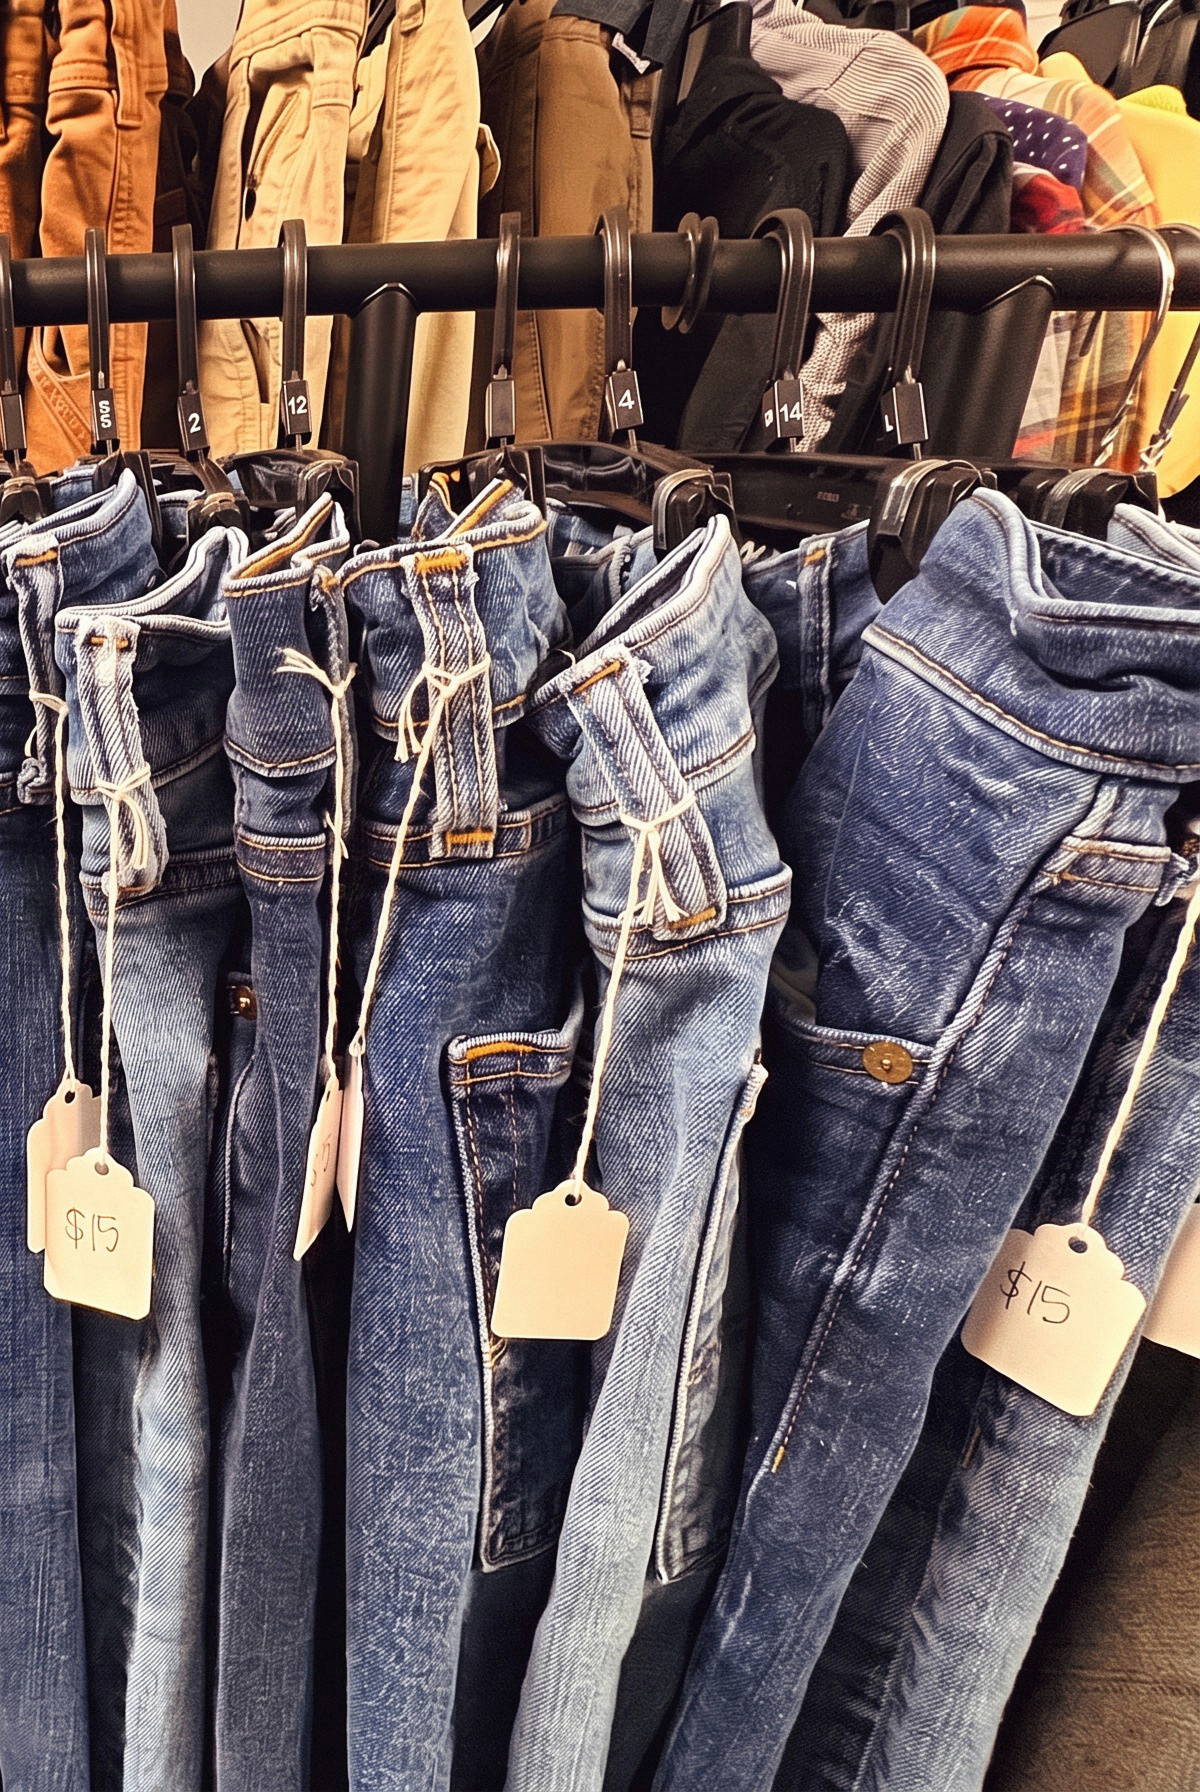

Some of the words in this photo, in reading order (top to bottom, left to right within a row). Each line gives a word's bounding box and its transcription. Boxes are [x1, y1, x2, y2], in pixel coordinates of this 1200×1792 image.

[287, 395, 308, 415] 12
[617, 389, 635, 410] 4
[187, 412, 202, 434] 2
[779, 401, 802, 423] 14
[65, 1207, 119, 1253] $15
[999, 1261, 1070, 1324] $15
